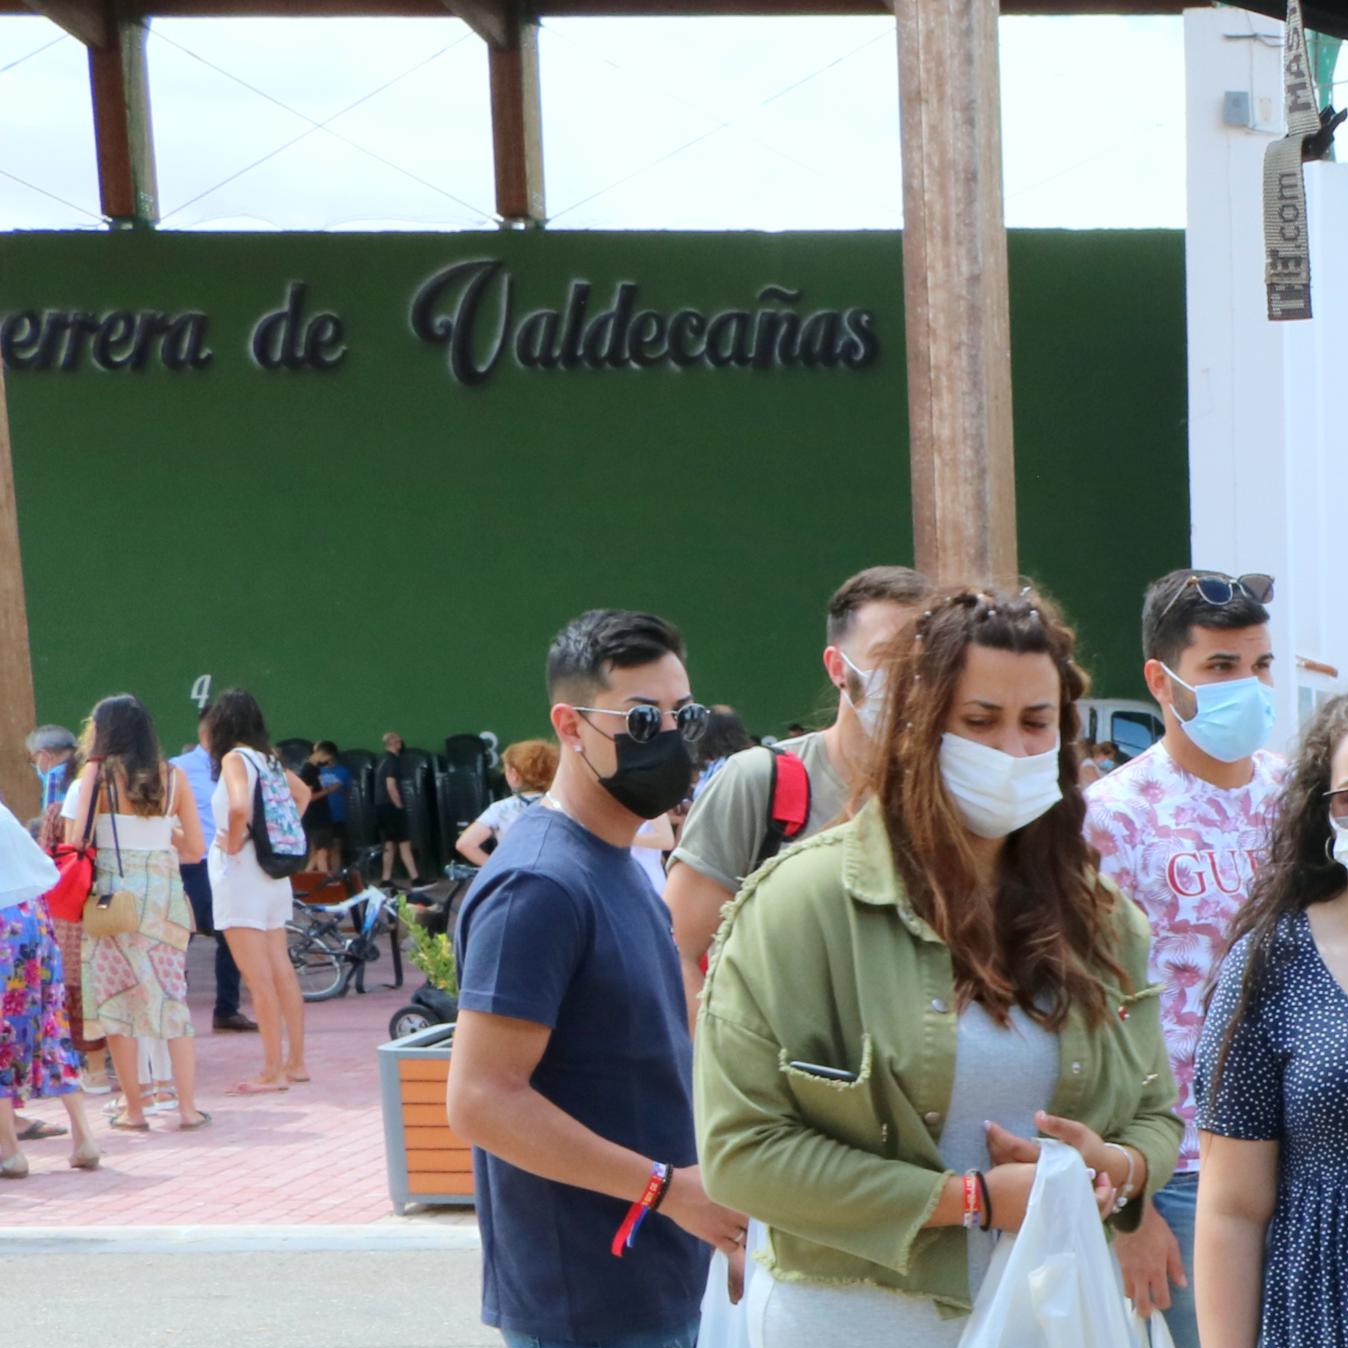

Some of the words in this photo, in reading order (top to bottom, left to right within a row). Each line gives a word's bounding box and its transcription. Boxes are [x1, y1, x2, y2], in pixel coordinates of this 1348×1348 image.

[249, 281, 348, 371] de
[410, 258, 880, 387] Valdecañas
[190, 673, 212, 709] 4
[479, 731, 499, 769] 3
